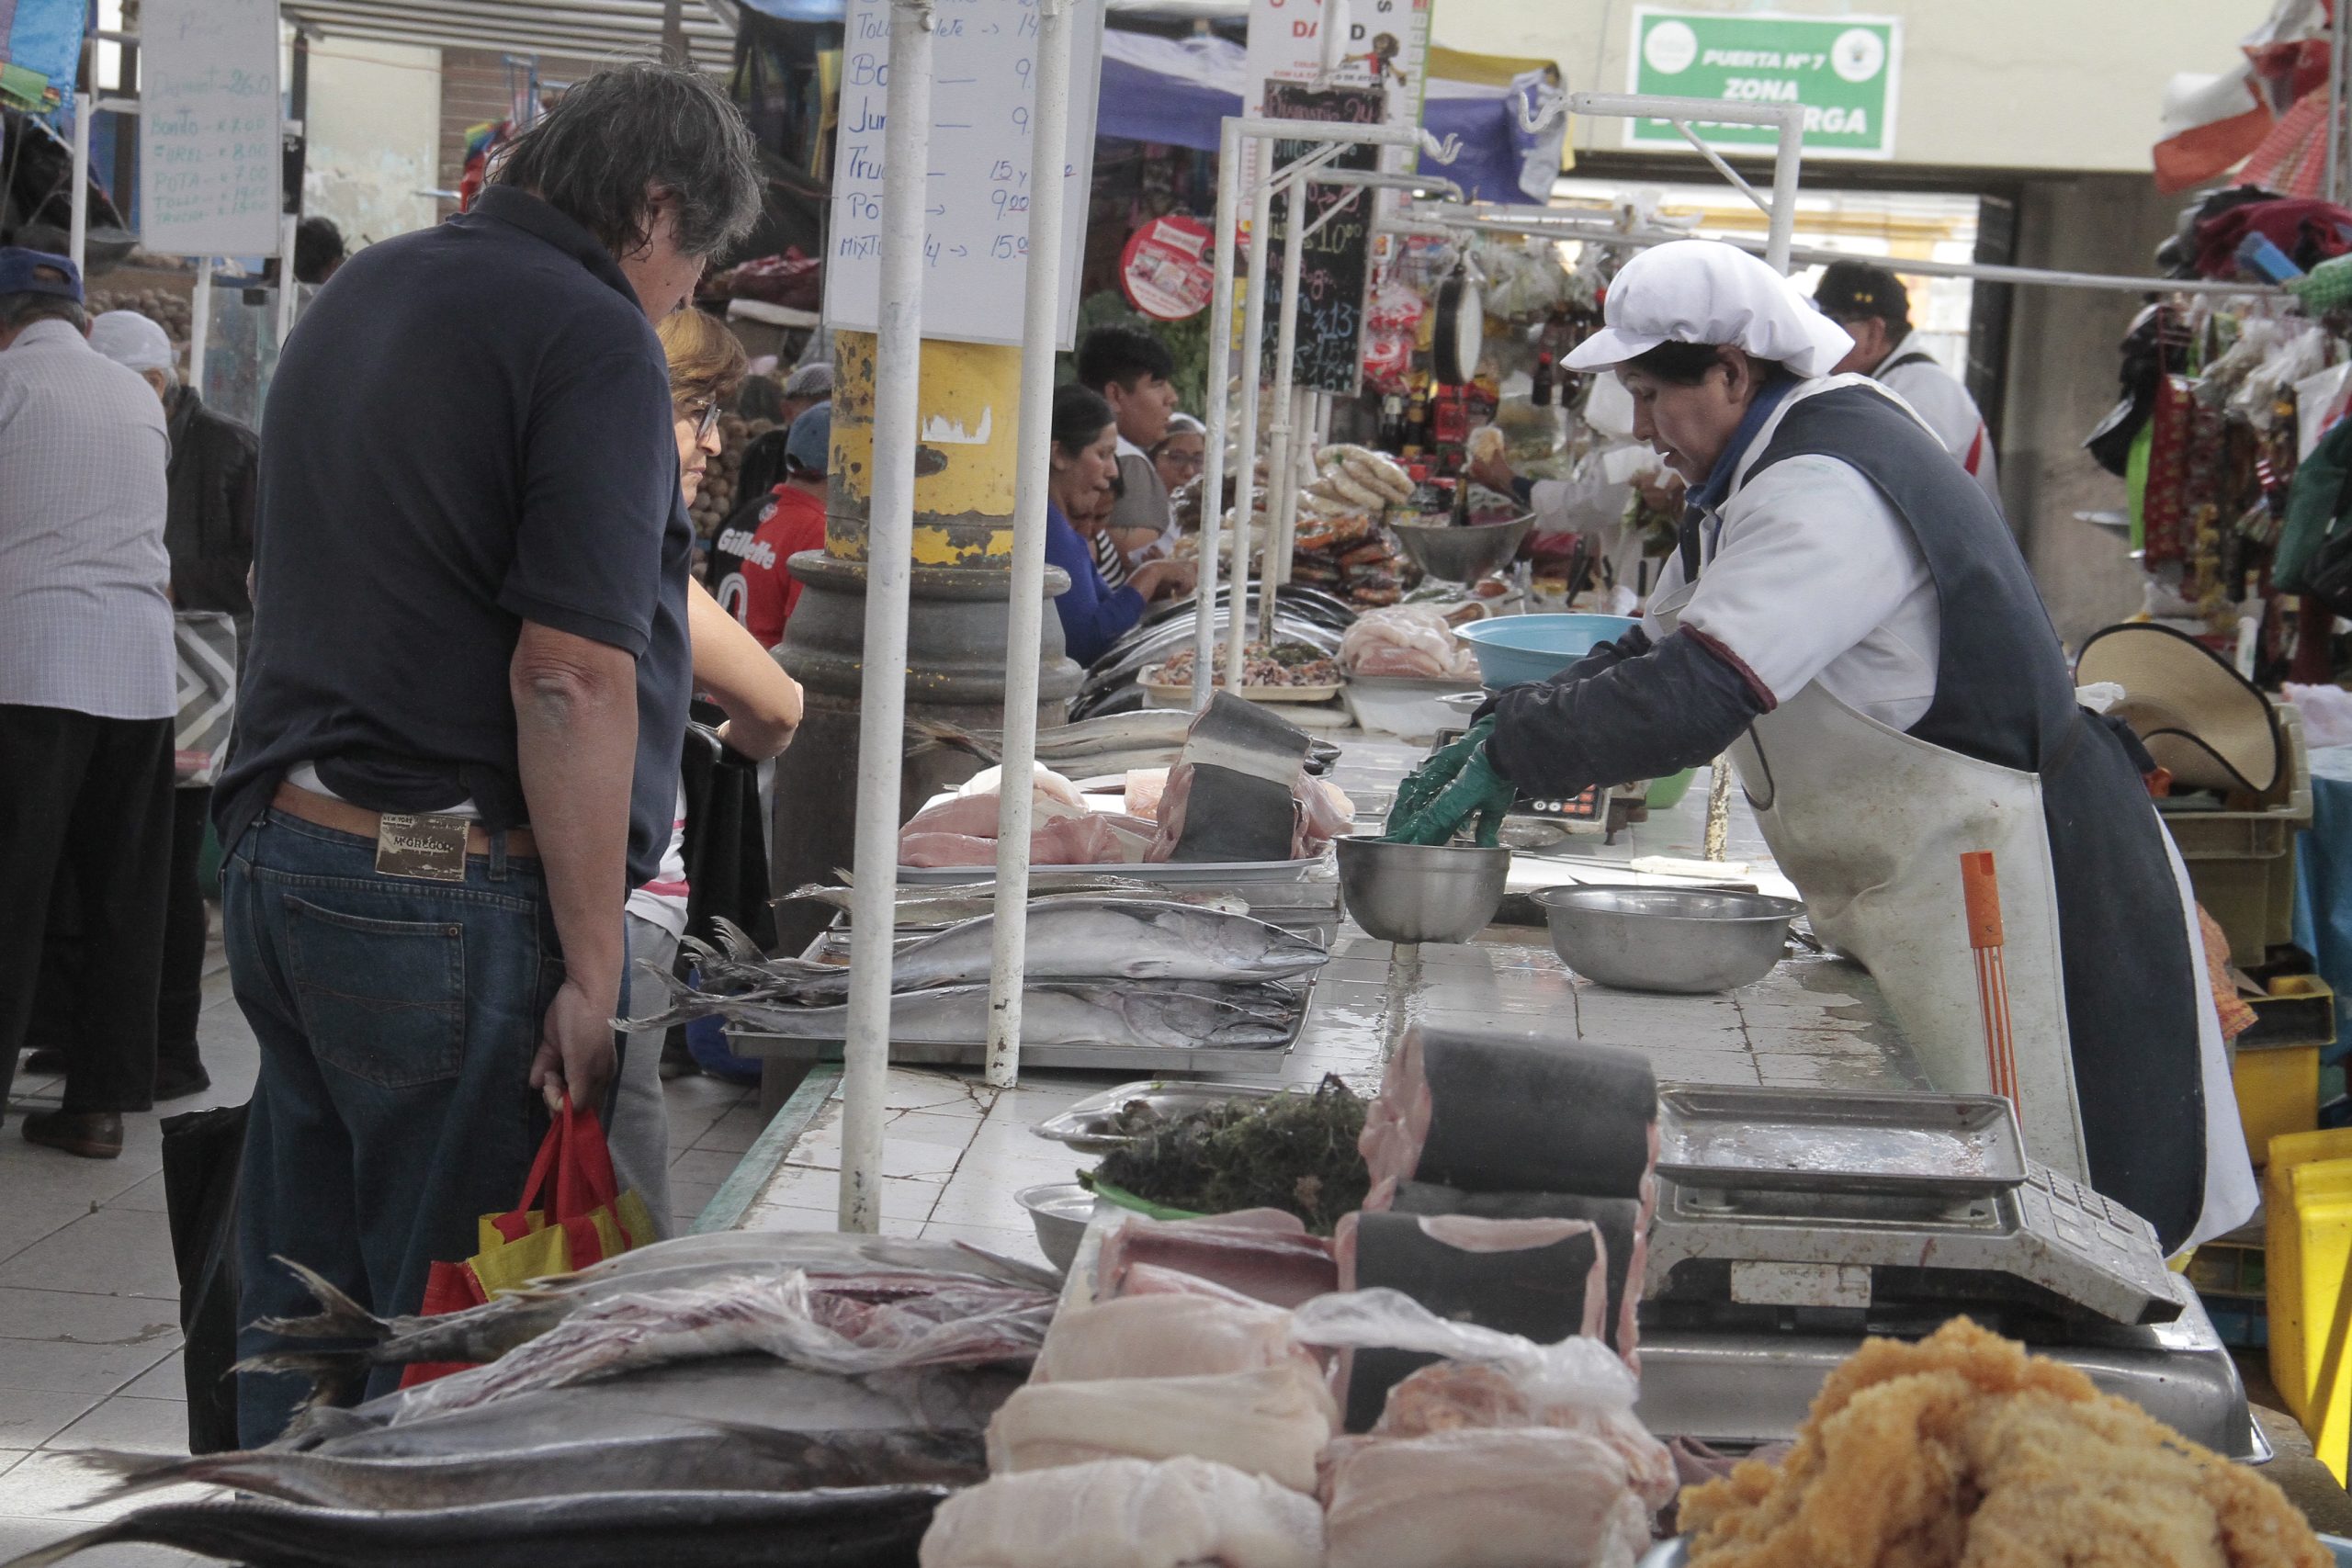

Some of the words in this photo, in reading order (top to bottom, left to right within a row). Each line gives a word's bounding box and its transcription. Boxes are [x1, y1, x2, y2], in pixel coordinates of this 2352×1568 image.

[1702, 50, 1781, 69] PUERTA
[1811, 55, 1826, 71] 7
[1724, 78, 1798, 100] ZONA
[718, 527, 776, 570] Gillette
